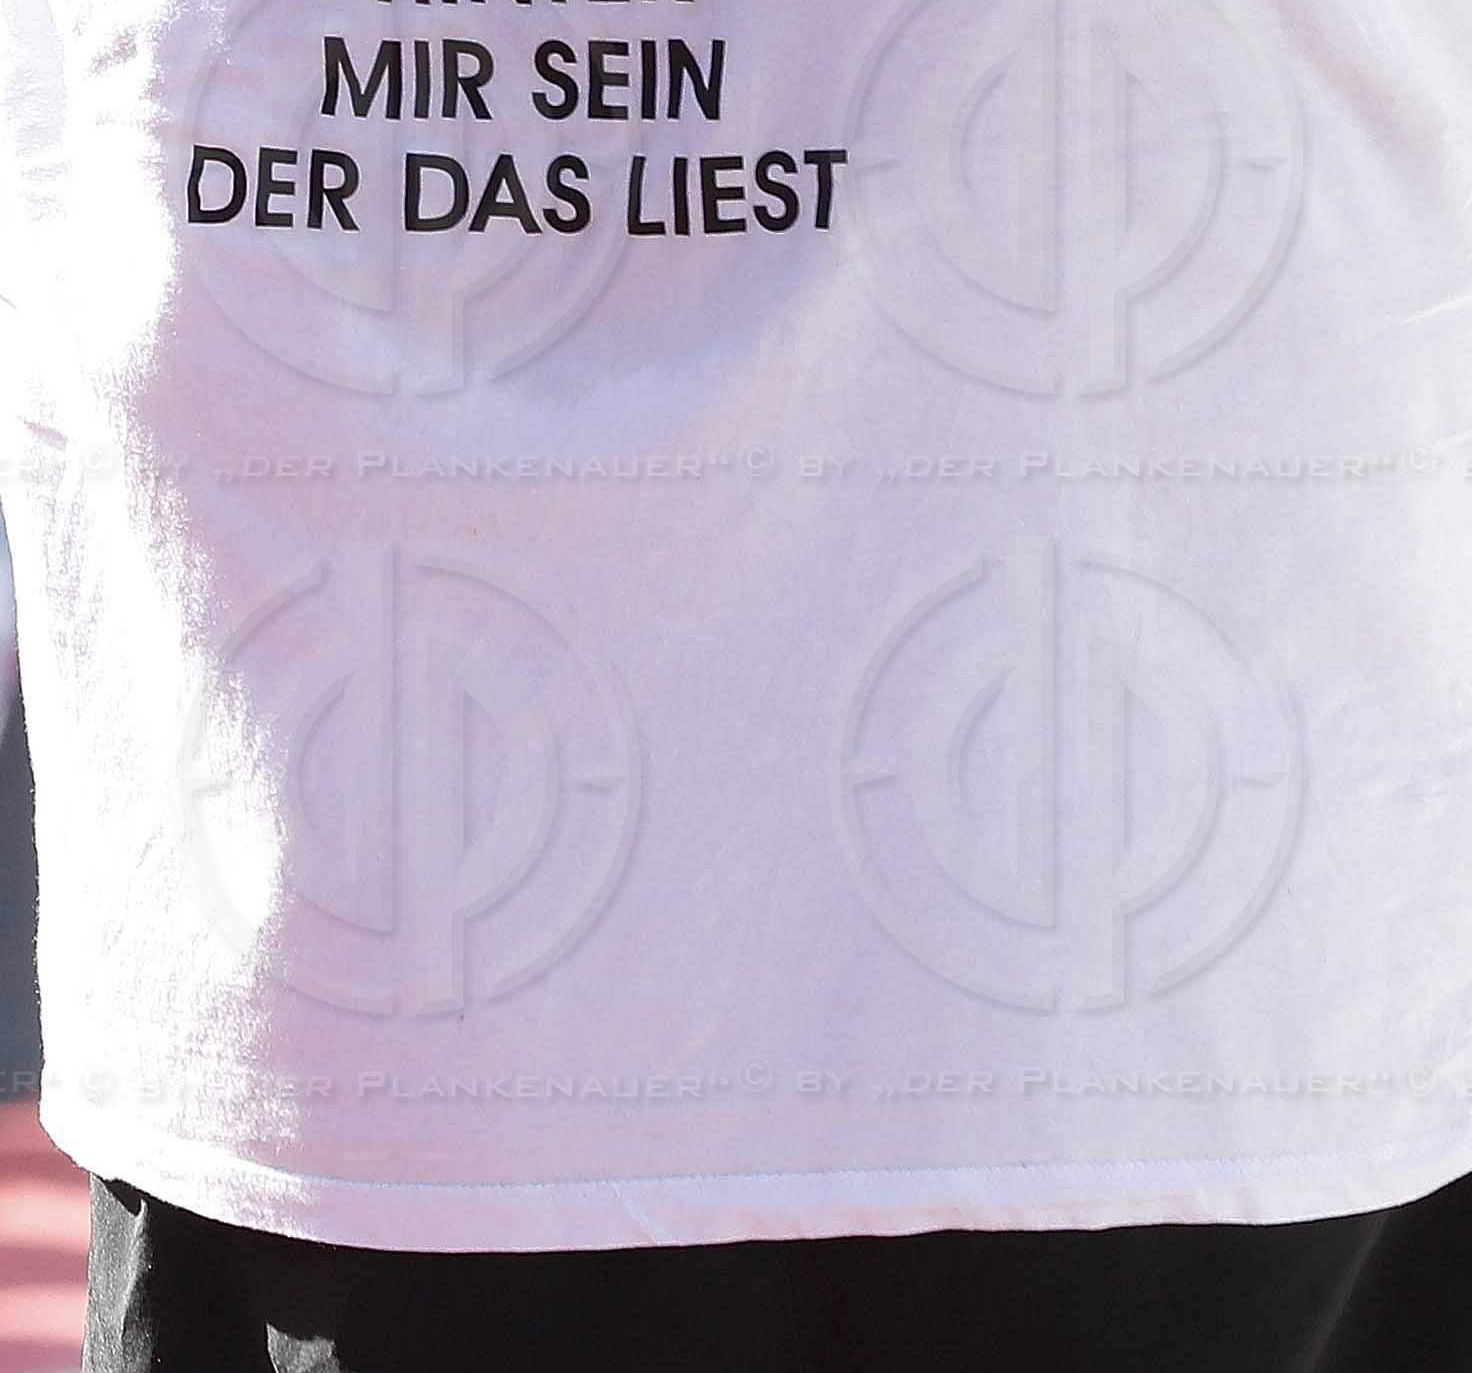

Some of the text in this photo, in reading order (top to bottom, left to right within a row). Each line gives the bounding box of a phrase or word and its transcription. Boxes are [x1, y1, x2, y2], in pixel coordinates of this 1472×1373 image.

[322, 37, 725, 120] MIR SEIN
[188, 145, 846, 235] DER DAS LIEST
